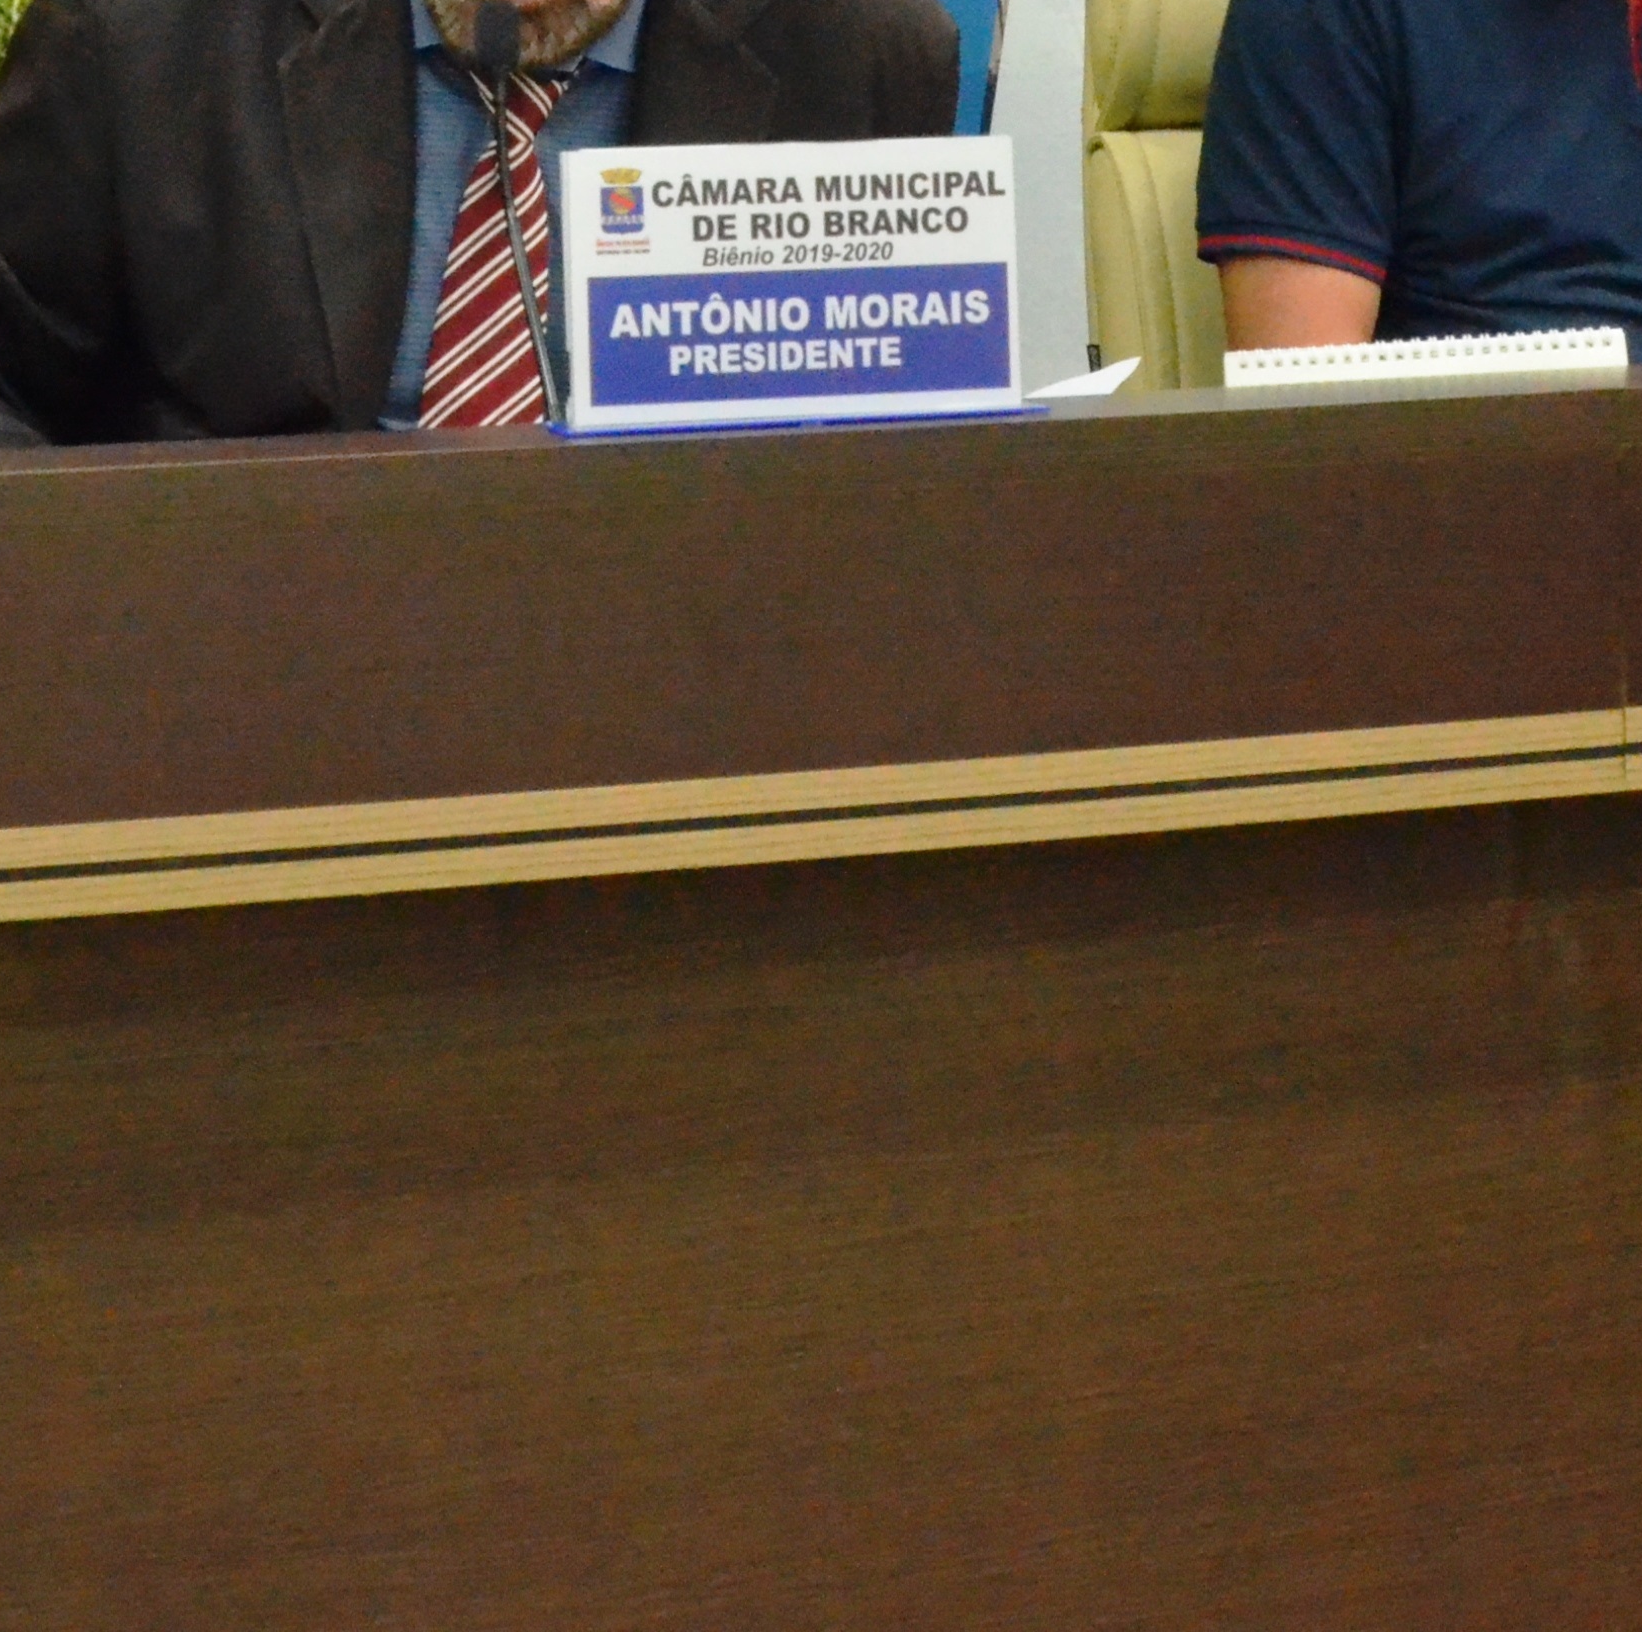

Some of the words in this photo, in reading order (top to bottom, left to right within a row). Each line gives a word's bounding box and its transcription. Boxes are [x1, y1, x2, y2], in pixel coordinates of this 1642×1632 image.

[652, 174, 804, 207] CÂMARA
[815, 171, 1006, 202] MUNICIPAL
[692, 214, 736, 243] DE
[751, 211, 810, 240] RIO
[824, 207, 968, 237] BRANCO
[702, 243, 774, 267] Biênio
[783, 242, 894, 265] 2019-2020
[609, 293, 810, 339] ANTÔNIO
[825, 290, 991, 329] MORAIS
[670, 336, 902, 376] PRESIDENTE
